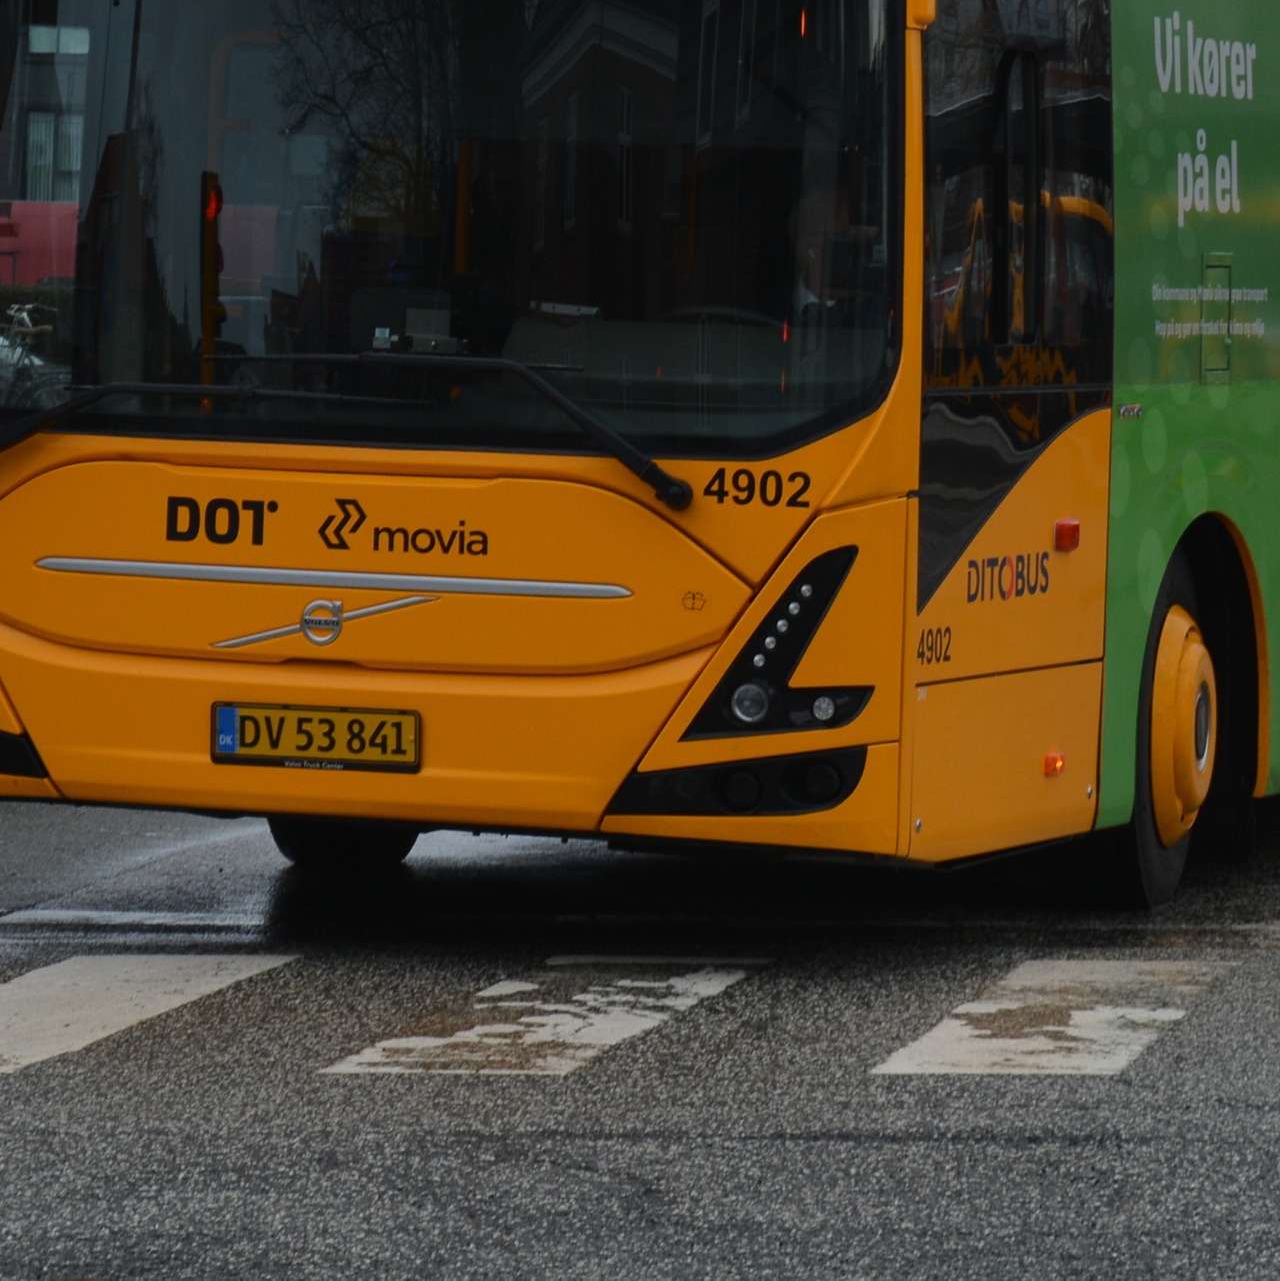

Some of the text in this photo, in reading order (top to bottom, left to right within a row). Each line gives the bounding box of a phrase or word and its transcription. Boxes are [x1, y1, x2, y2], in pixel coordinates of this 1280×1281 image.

[1154, 11, 1256, 100] Vi kører
[1177, 129, 1241, 227] på el
[703, 467, 811, 508] 4902
[166, 496, 277, 546] DOT
[373, 520, 488, 555] movia
[966, 551, 1050, 603] DITOBUS
[303, 618, 340, 628] VOLVO
[916, 626, 952, 665] 4902
[219, 734, 233, 746] DK
[239, 715, 407, 756] DV 53 841
[284, 760, 302, 768] Volvo
[303, 760, 320, 768] Truck
